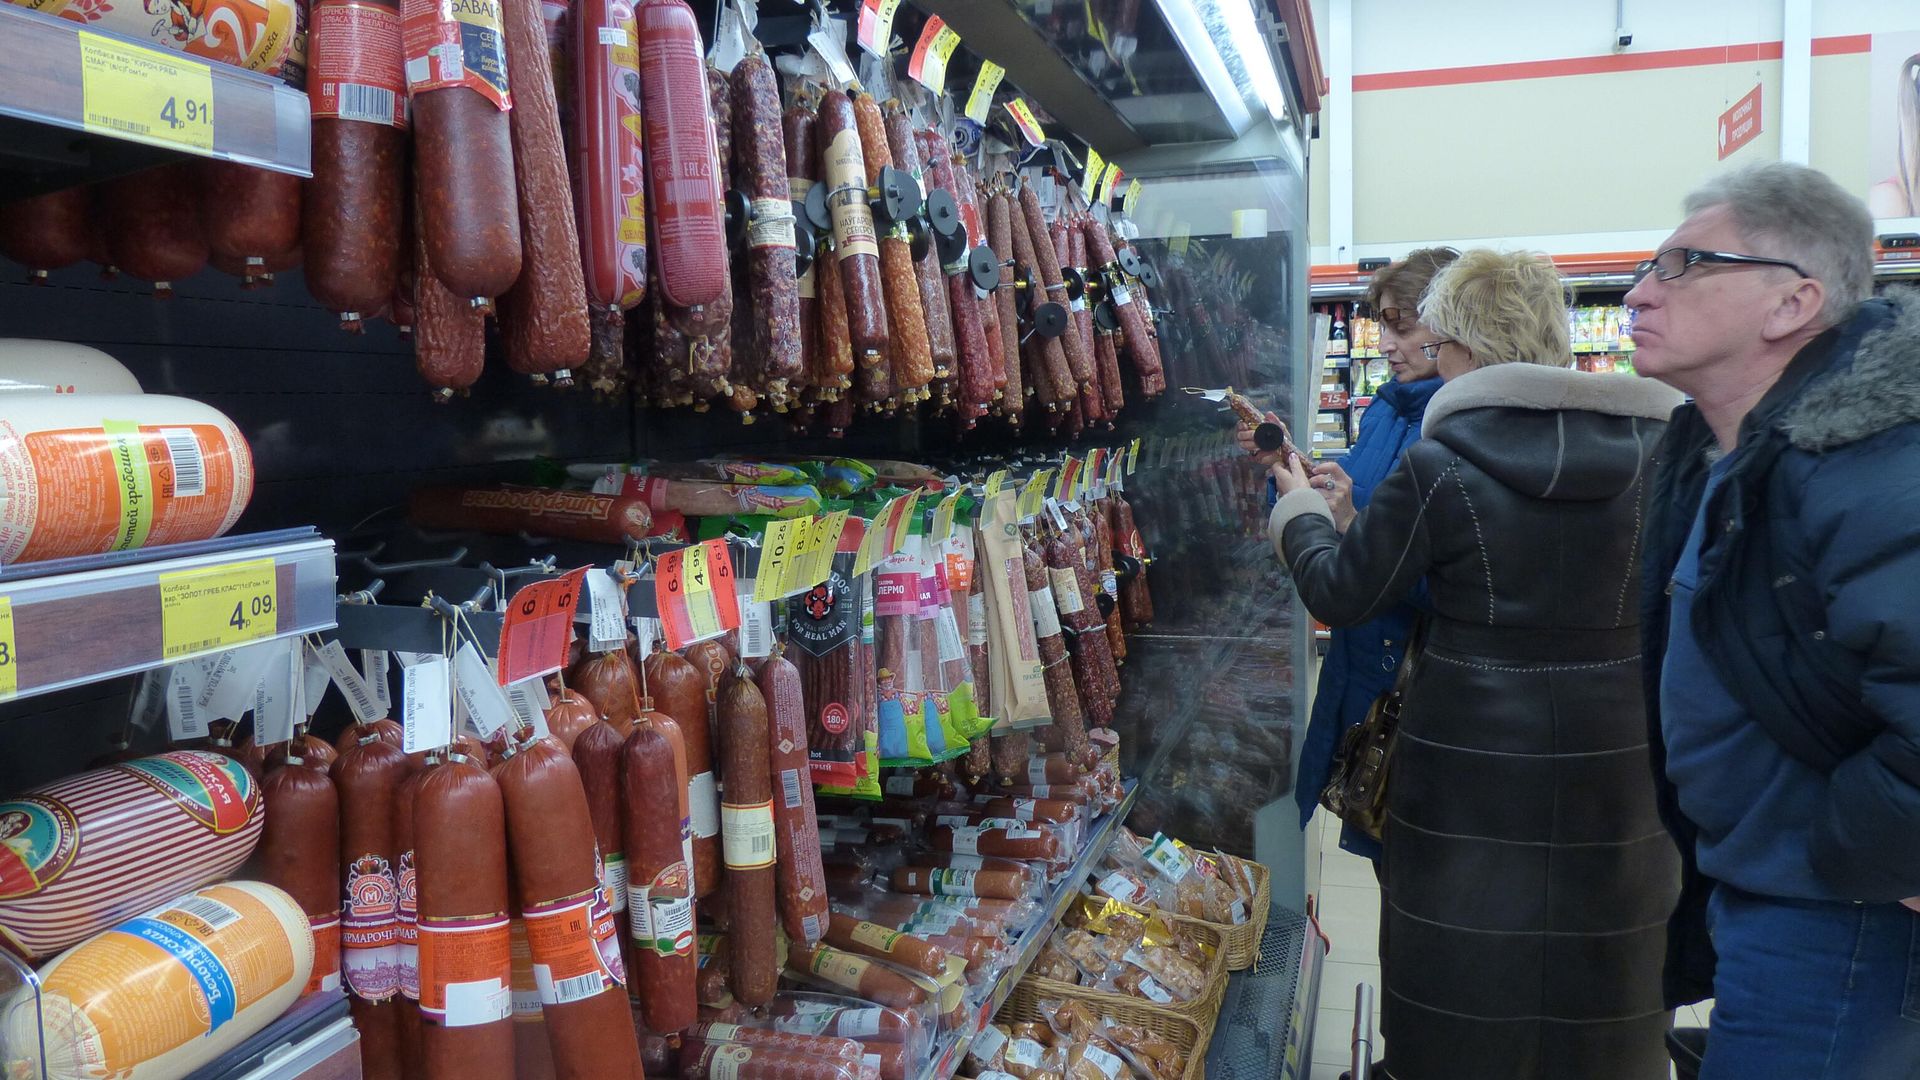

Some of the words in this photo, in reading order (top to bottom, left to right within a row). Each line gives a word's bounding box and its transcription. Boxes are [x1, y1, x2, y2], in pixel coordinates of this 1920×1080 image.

[464, 487, 615, 521] Бутербродная
[163, 584, 190, 593] Колбаса
[804, 631, 828, 641] REAL
[829, 620, 847, 638] MAN
[826, 715, 840, 724] 180
[810, 763, 832, 771] ТРЫЙ
[143, 927, 222, 1005] Белорусская
